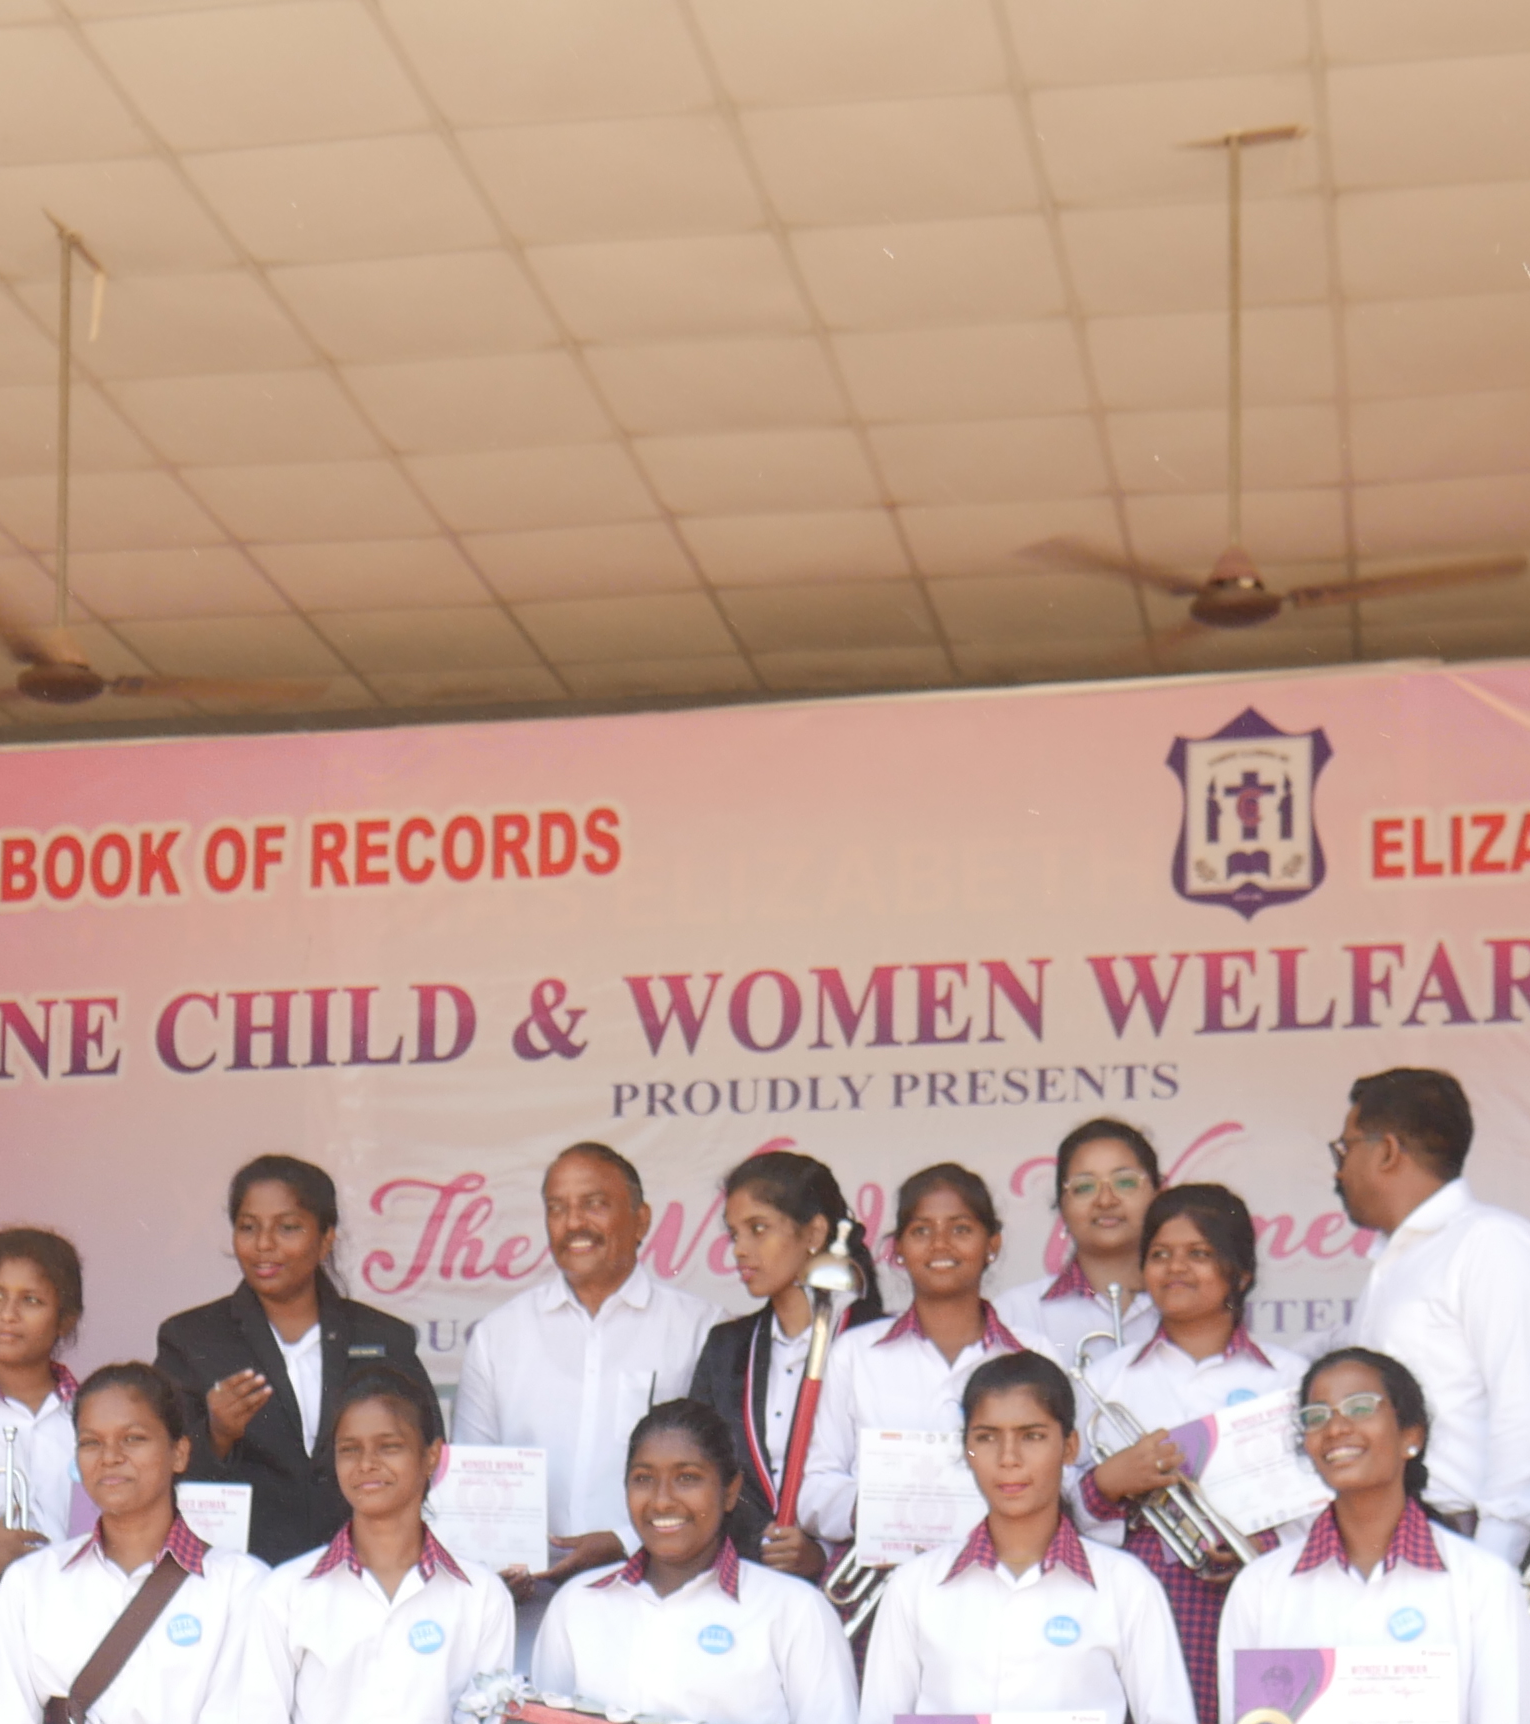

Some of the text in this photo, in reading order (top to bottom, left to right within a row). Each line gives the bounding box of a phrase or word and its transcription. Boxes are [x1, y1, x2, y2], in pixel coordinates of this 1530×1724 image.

[203, 825, 287, 893] OF
[309, 807, 622, 889] RECORDS
[155, 983, 478, 1075] CHILD
[511, 977, 589, 1062] &
[622, 957, 1053, 1058] WOMEN
[611, 1061, 1180, 1119] PROUDLY PRESENTS
[361, 1172, 551, 1295] The
